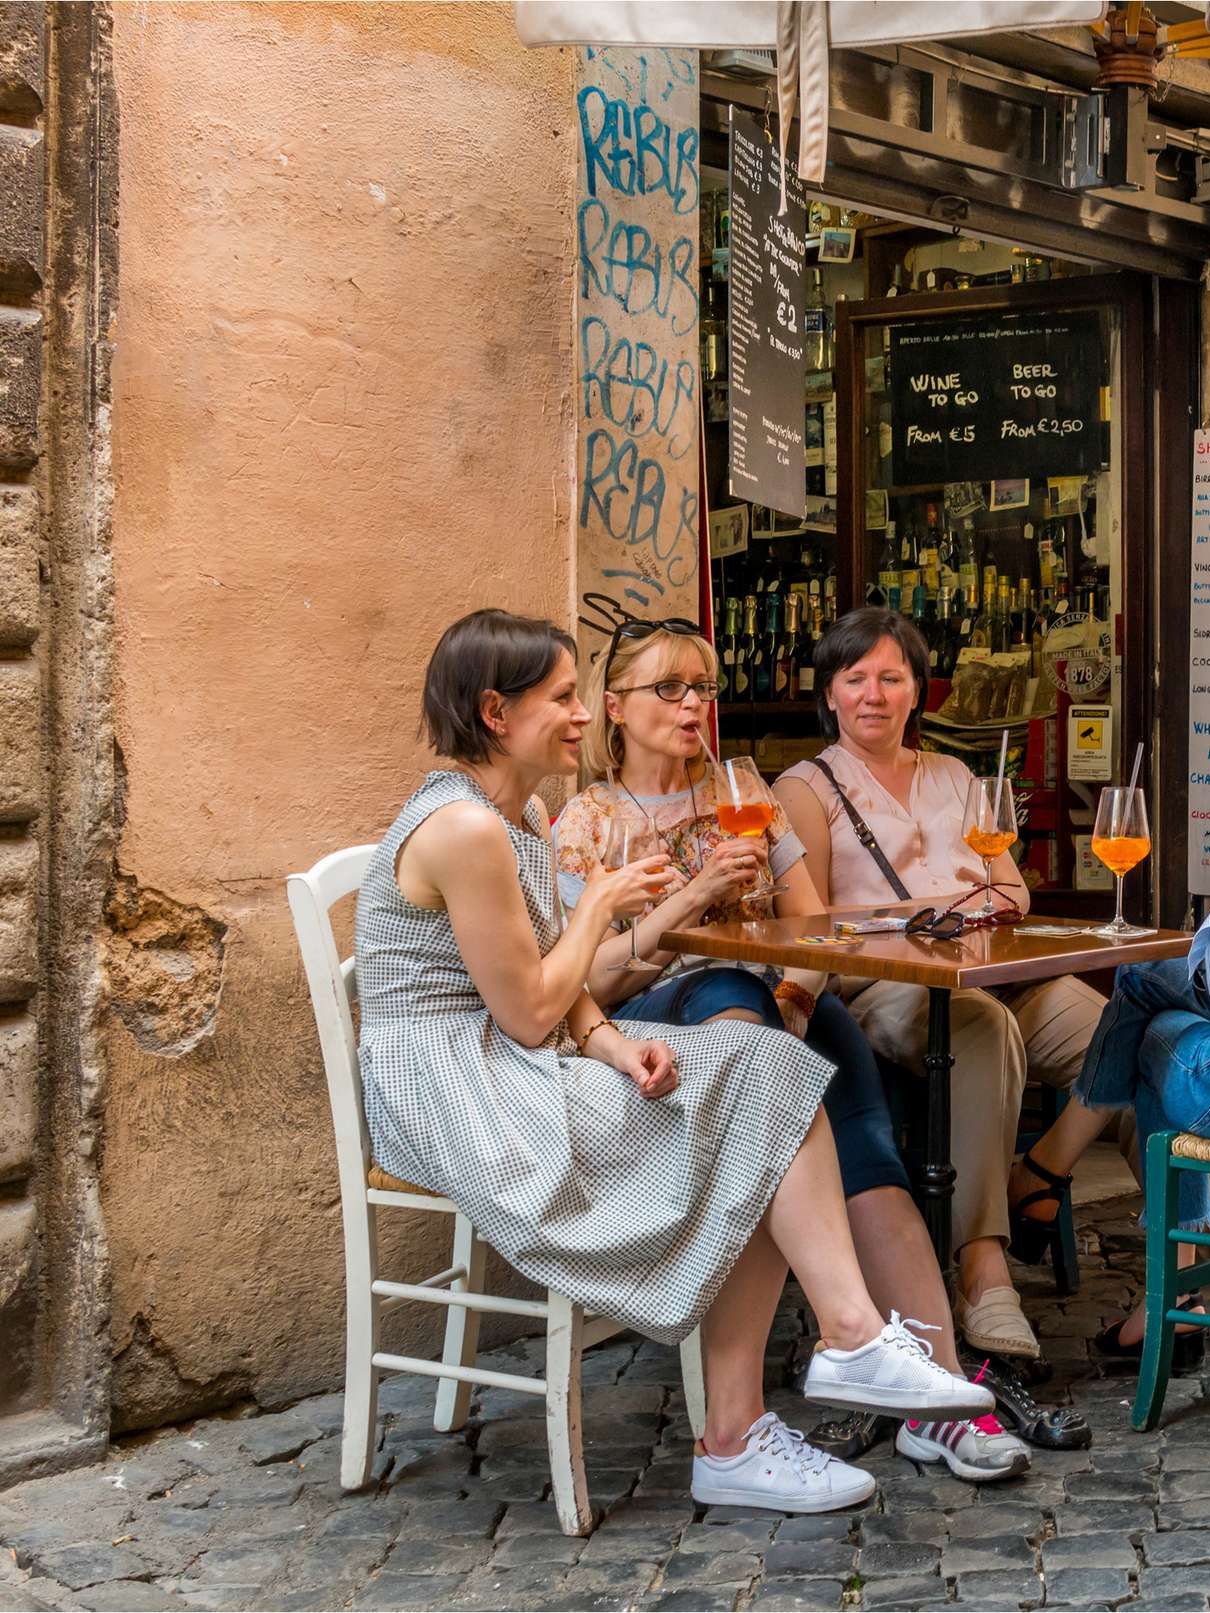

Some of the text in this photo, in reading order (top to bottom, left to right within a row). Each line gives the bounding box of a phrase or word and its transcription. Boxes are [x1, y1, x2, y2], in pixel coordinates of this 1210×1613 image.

[577, 85, 699, 215] REBUS
[579, 197, 699, 336] REBUS
[1013, 364, 1058, 380] BEER
[581, 316, 699, 459] REBUS
[911, 373, 961, 392] WINE
[1010, 384, 1057, 400] TO GO
[928, 391, 978, 407] TO GO
[907, 425, 976, 446] FROM €5
[1001, 419, 1036, 439] FROM
[580, 431, 699, 586] REBUS
